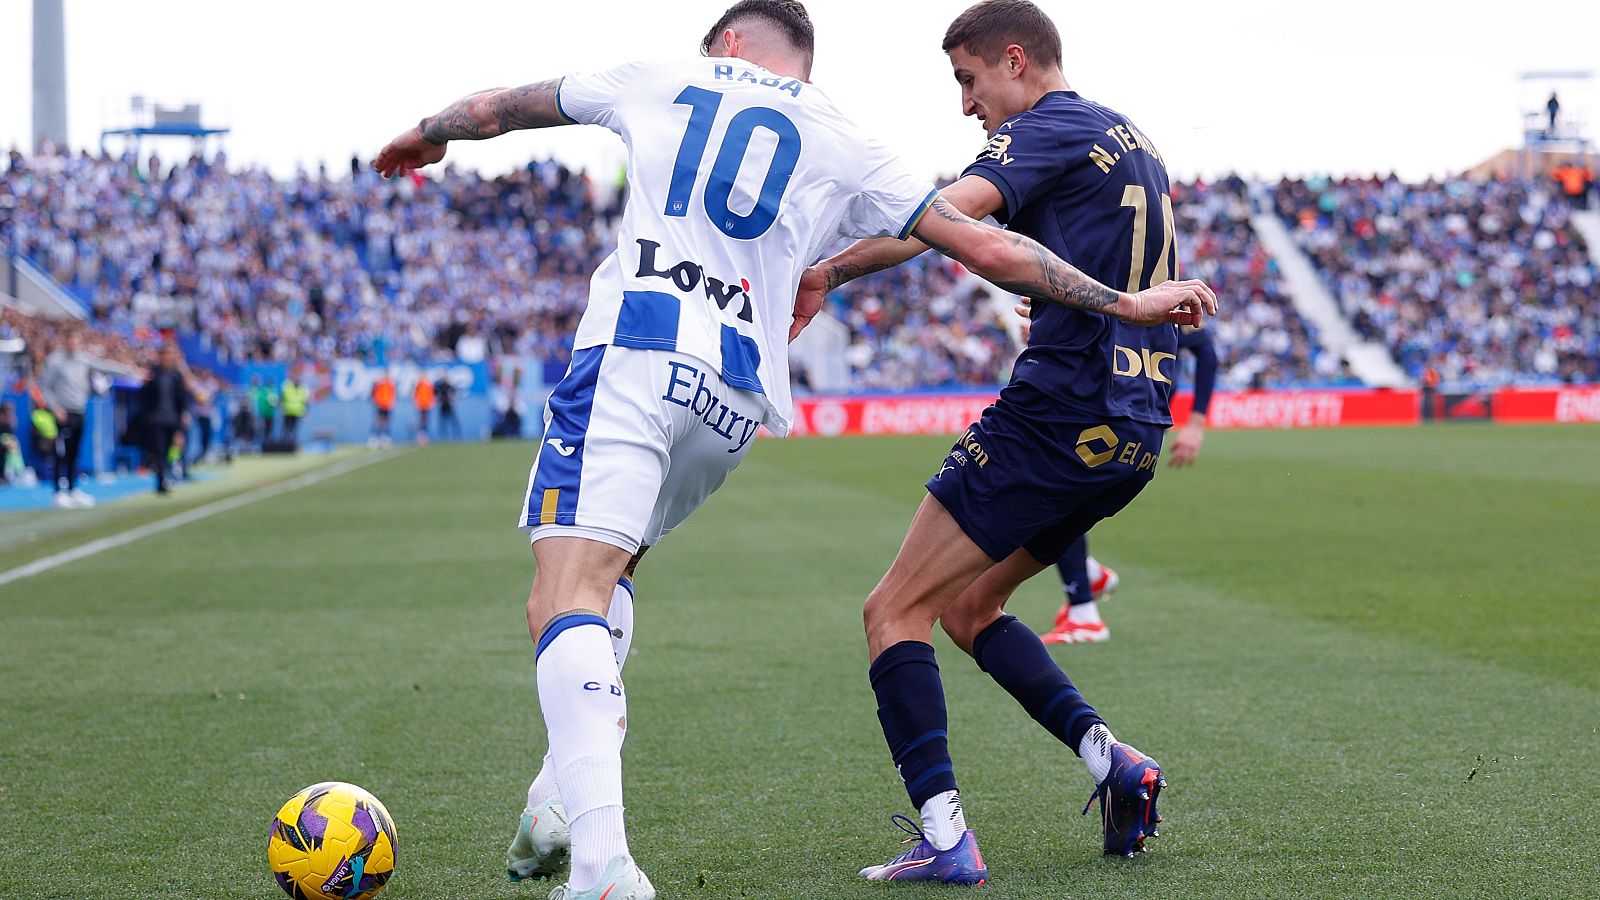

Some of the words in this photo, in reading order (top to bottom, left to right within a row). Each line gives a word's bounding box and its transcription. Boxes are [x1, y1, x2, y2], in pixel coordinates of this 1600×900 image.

[664, 85, 802, 239] 10
[1088, 143, 1120, 174] N.
[635, 238, 753, 323] Lowi
[1120, 185, 1179, 293] 14
[662, 361, 759, 453] Ebury
[1118, 441, 1142, 465] El
